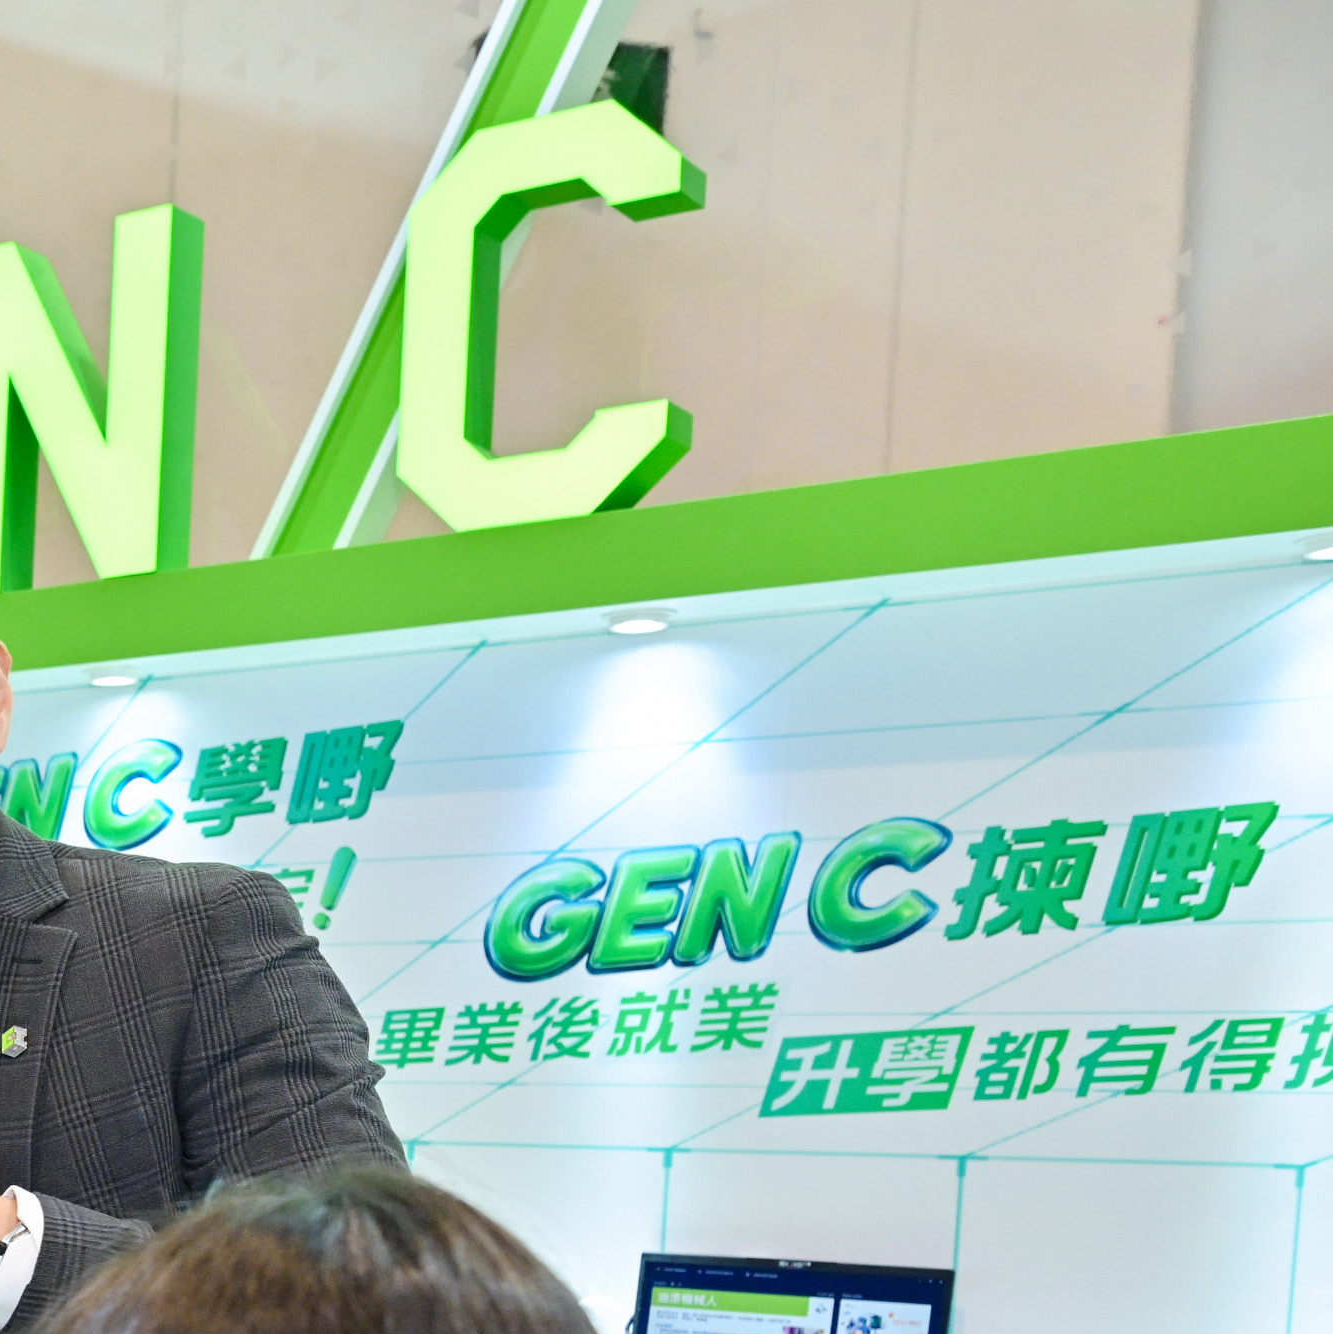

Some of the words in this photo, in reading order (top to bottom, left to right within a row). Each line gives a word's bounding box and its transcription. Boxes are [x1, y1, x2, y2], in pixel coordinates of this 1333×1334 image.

[395, 97, 707, 533] C
[183, 718, 405, 838] 學嘢
[482, 829, 802, 983] GEN
[807, 817, 954, 954] C
[943, 801, 1280, 941] 揀嘢
[373, 983, 779, 1069] 畢業後就業
